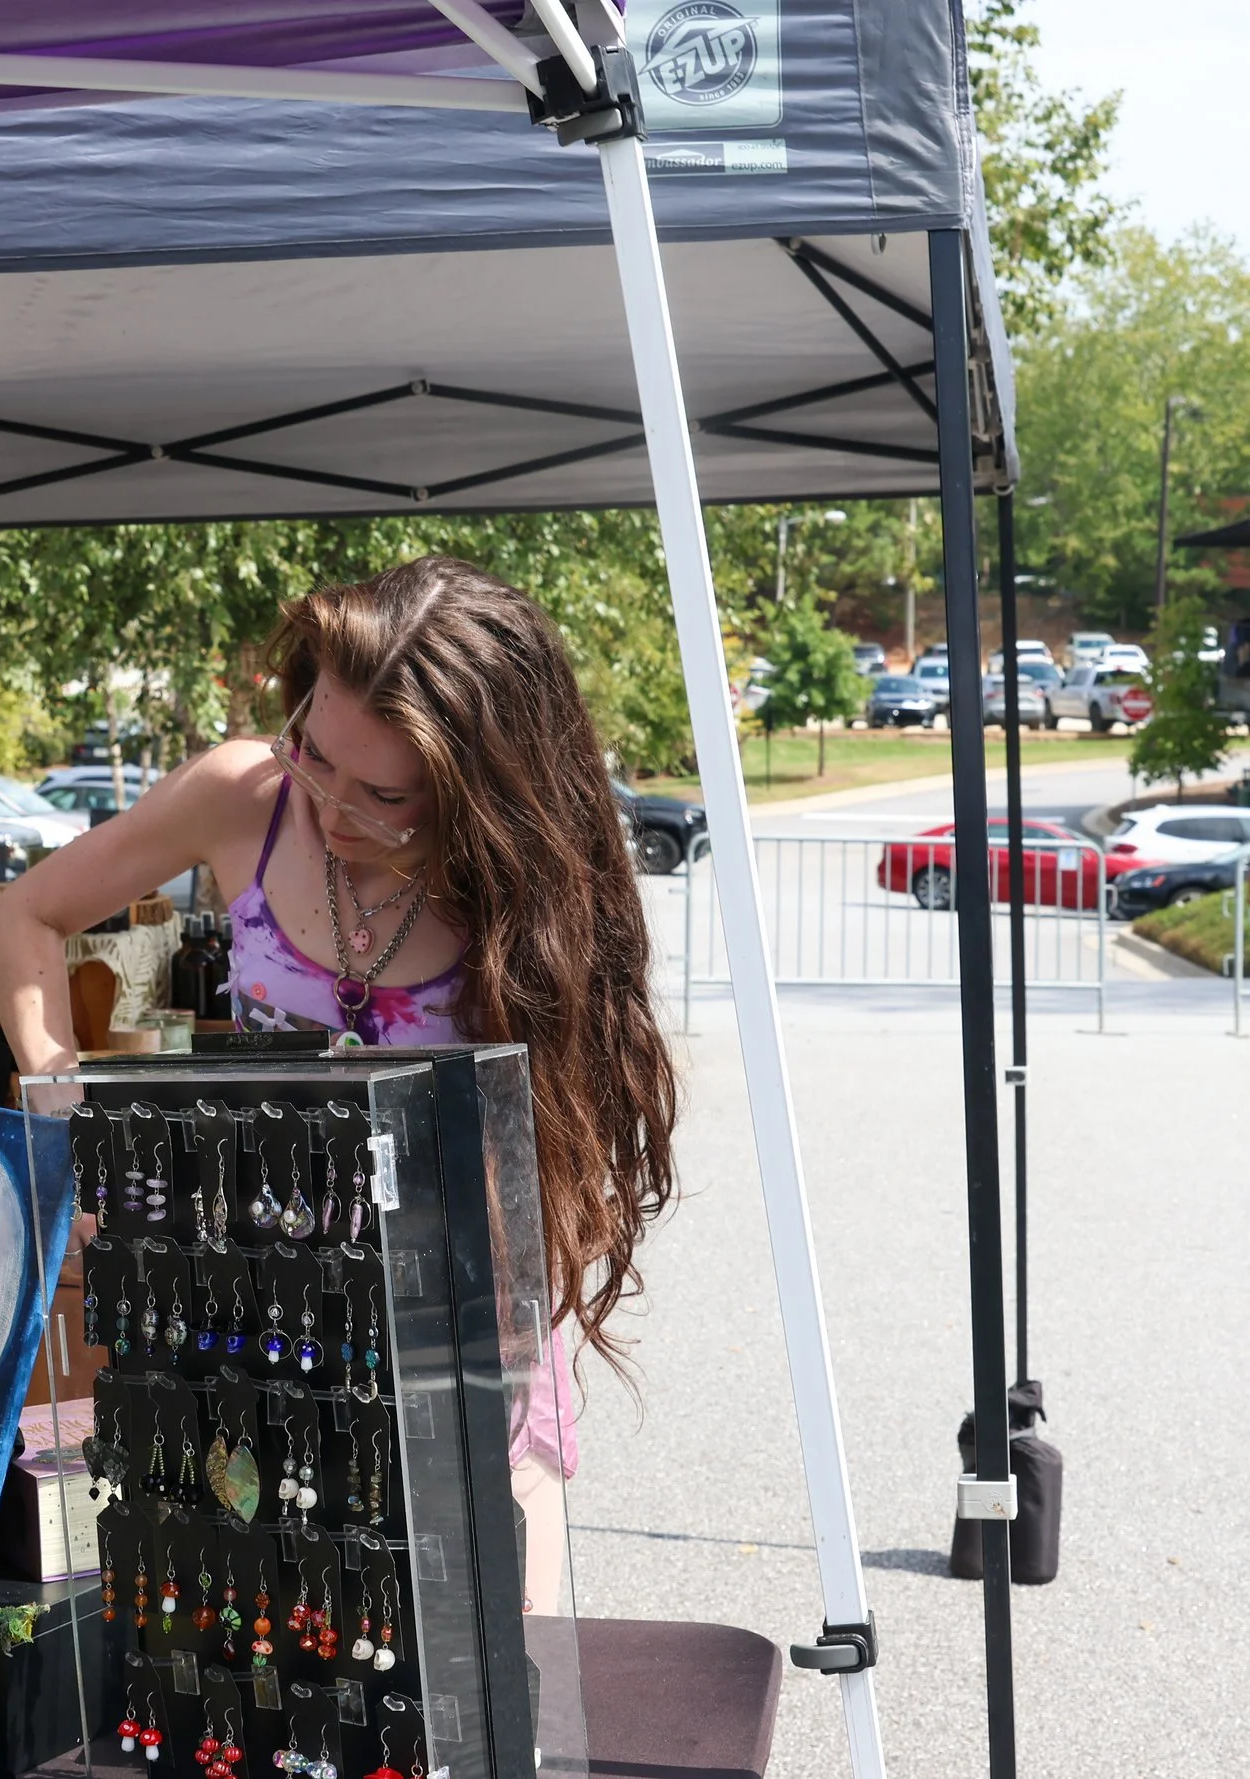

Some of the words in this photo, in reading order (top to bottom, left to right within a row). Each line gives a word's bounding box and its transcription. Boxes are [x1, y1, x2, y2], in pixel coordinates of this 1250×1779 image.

[657, 5, 718, 37] ORIGINAL
[699, 90, 727, 101] since
[731, 160, 783, 172] ezup.com
